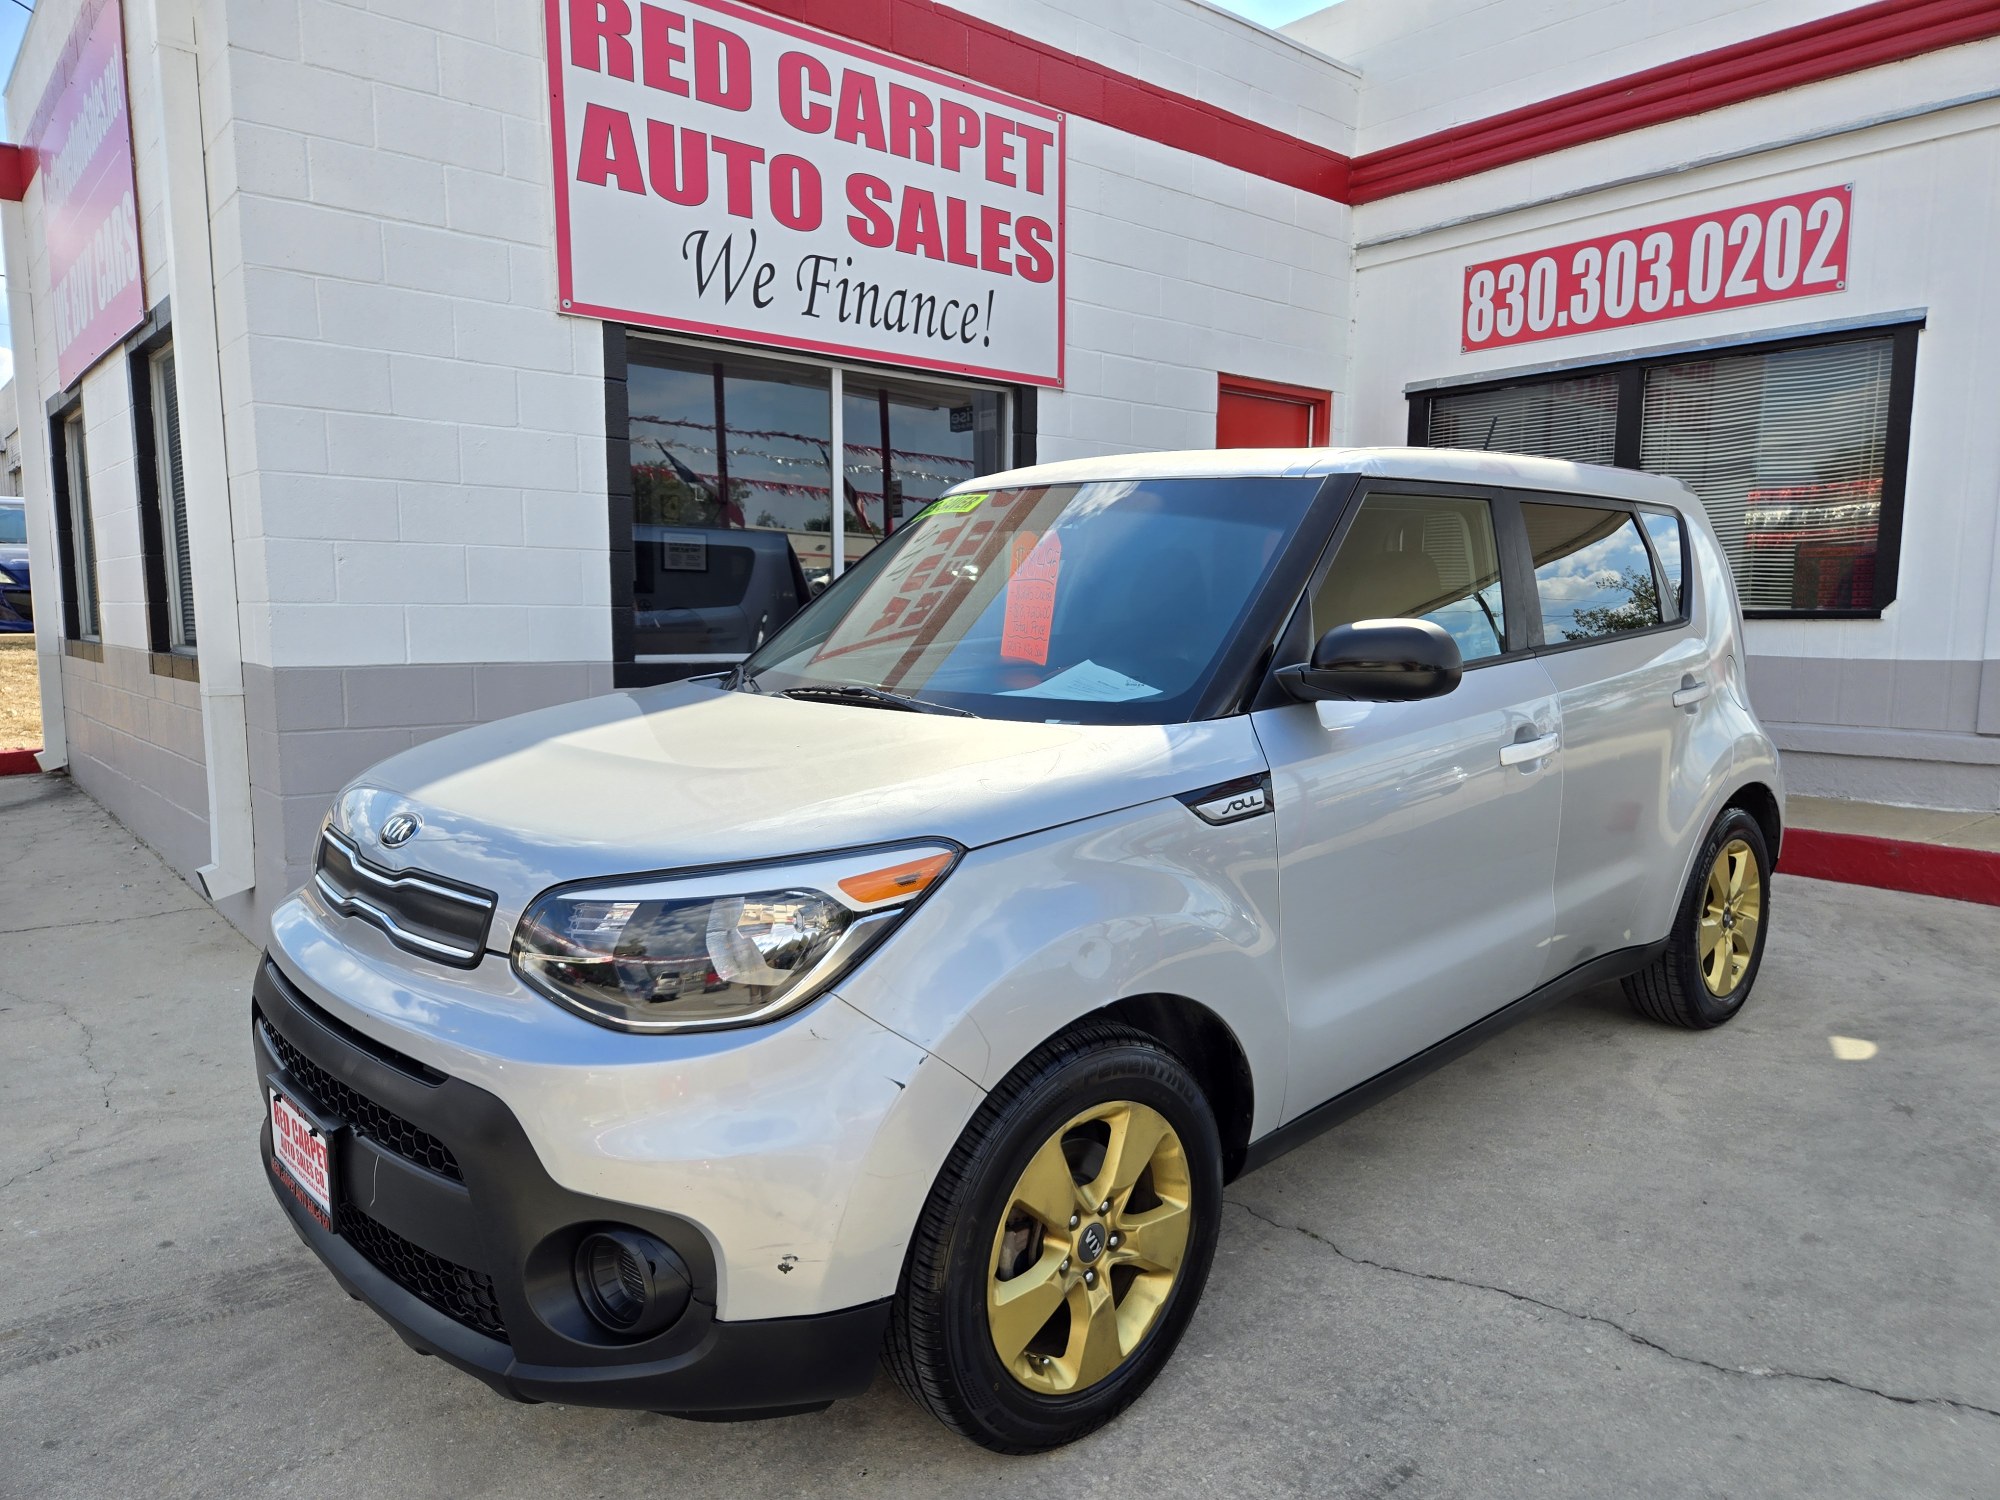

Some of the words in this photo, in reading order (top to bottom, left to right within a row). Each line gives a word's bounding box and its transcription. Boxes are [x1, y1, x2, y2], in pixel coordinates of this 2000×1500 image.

[570, 0, 752, 112] RED
[778, 51, 1054, 195] CARPET
[576, 102, 823, 232] AUTO
[845, 172, 1054, 284] SALES
[53, 274, 72, 357] WE
[69, 239, 94, 339] BUY
[94, 190, 138, 311] CARS
[682, 228, 776, 308] We
[796, 254, 995, 347] Finance!
[1464, 196, 1845, 343] 830.303.0202
[1222, 796, 1262, 815] SOUL
[273, 1100, 290, 1137] RED
[291, 1118, 328, 1173] CARPET
[296, 1148, 314, 1179] SALES
[1085, 1229, 1102, 1257] KIA
